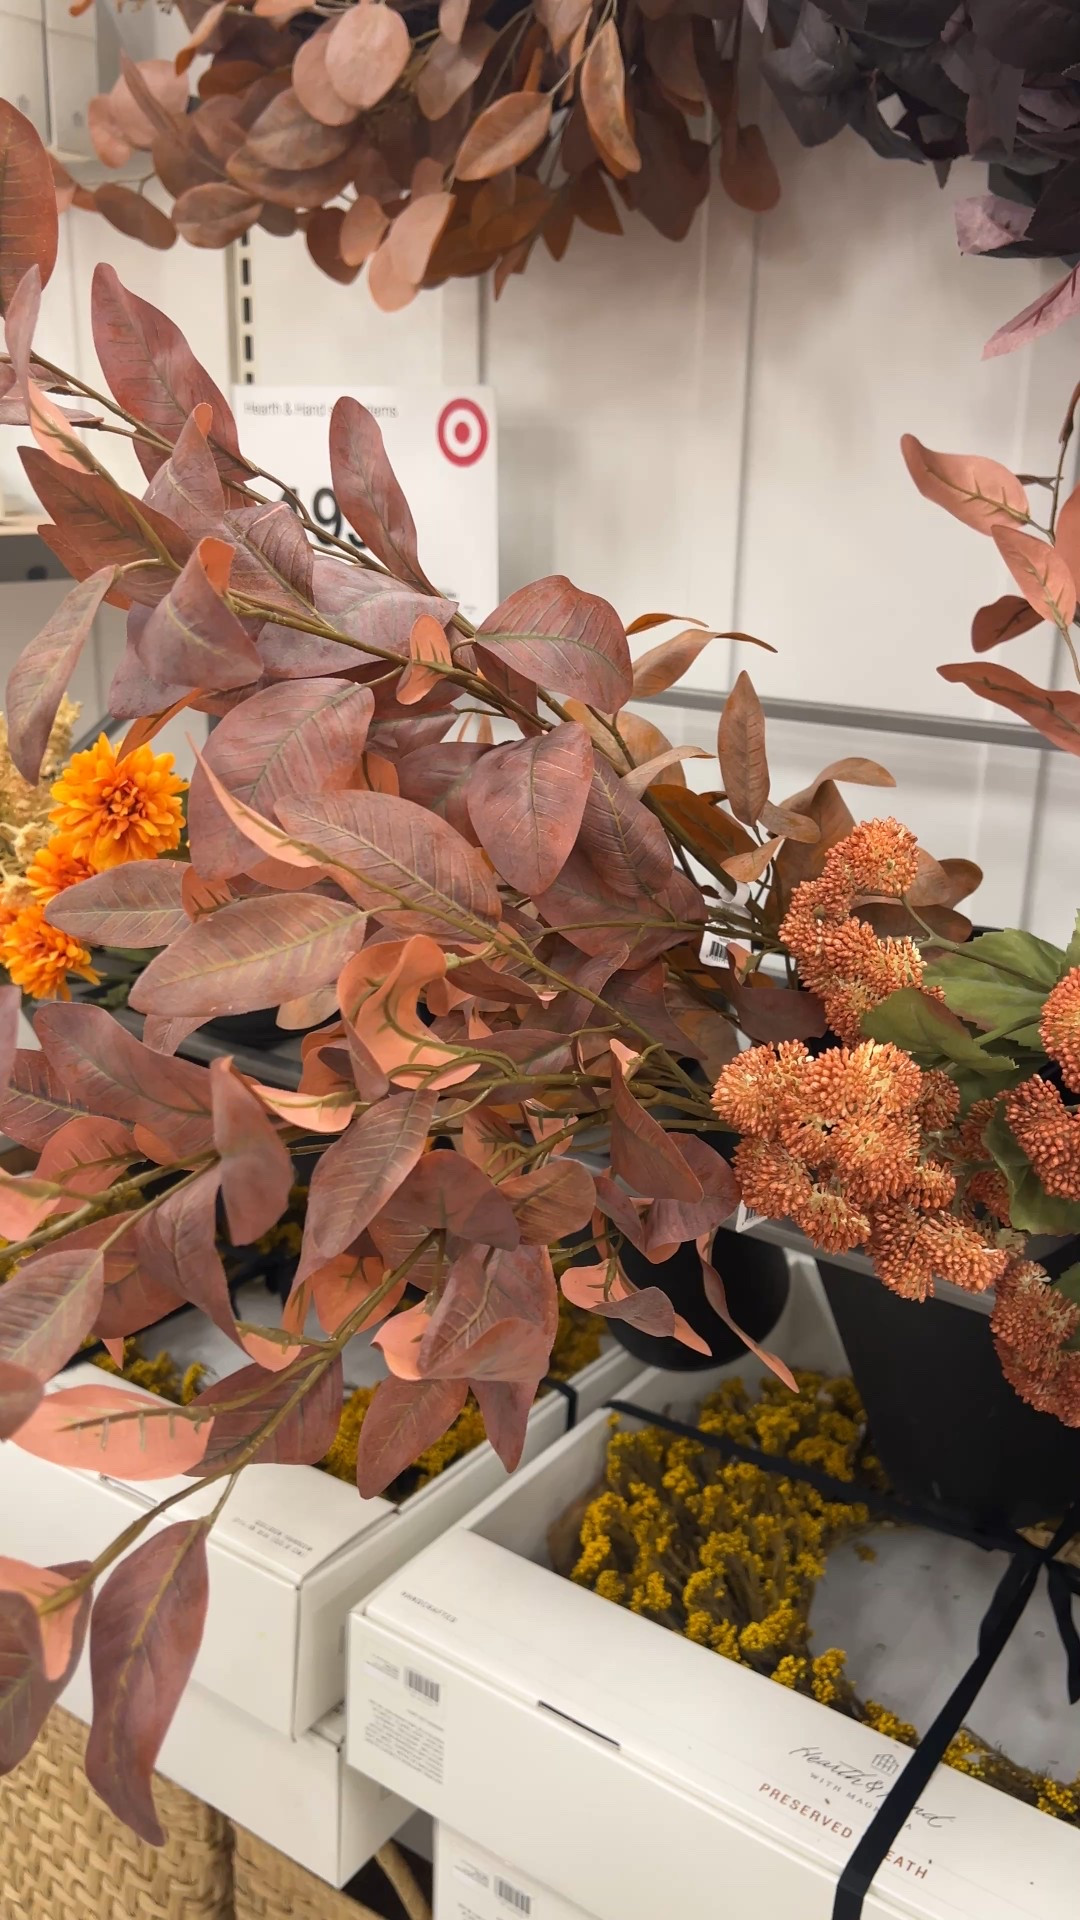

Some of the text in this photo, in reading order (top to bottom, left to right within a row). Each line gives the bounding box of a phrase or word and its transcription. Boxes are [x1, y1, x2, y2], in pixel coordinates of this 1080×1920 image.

[788, 1746, 877, 1787] Hearth
[864, 1779, 885, 1794] &
[809, 1772, 842, 1793] WITH
[758, 1782, 929, 1880] PRESERVED EATH
